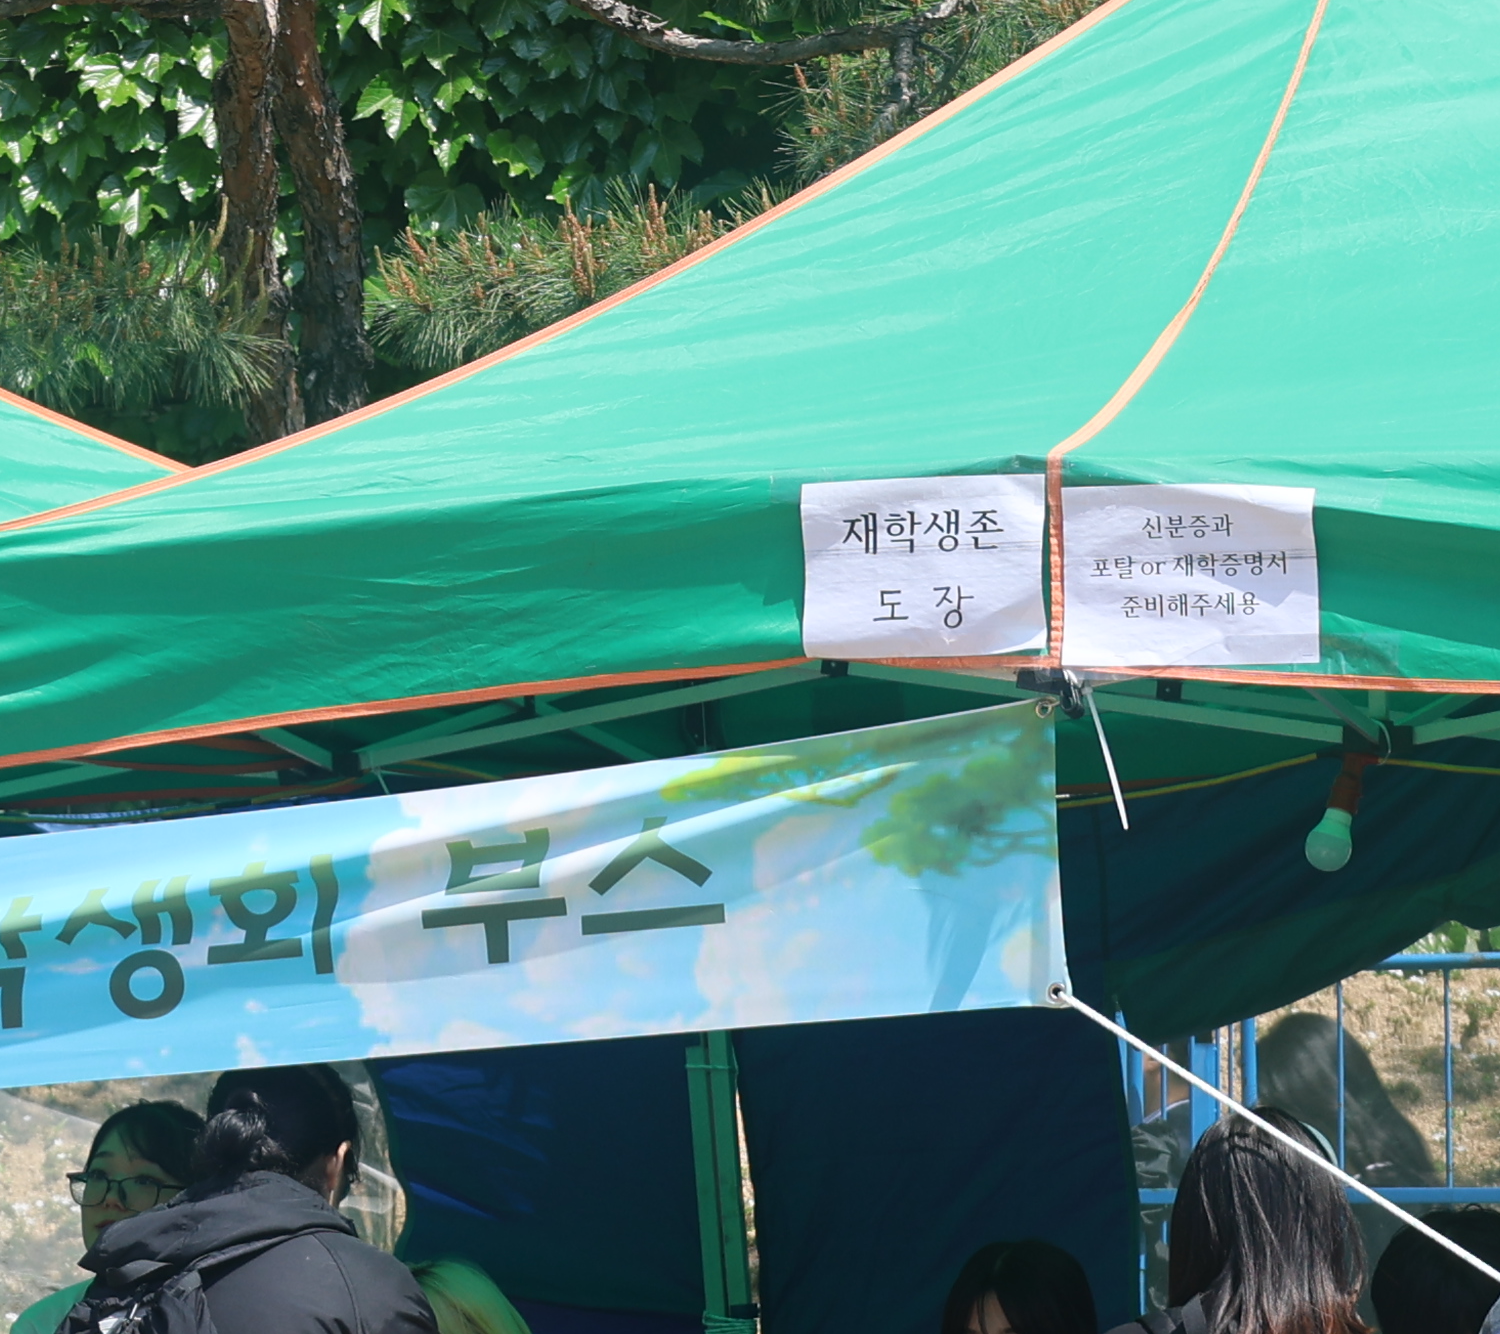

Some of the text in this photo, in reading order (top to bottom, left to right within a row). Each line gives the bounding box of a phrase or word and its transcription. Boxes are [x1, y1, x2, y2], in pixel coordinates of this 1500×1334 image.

[842, 509, 1004, 556] 재학생존
[1141, 513, 1234, 540] 신분증과
[1089, 551, 1288, 580] 포탈 or 재학증명서
[1120, 591, 1261, 619] 준비해주세용
[420, 815, 727, 966] 부스
